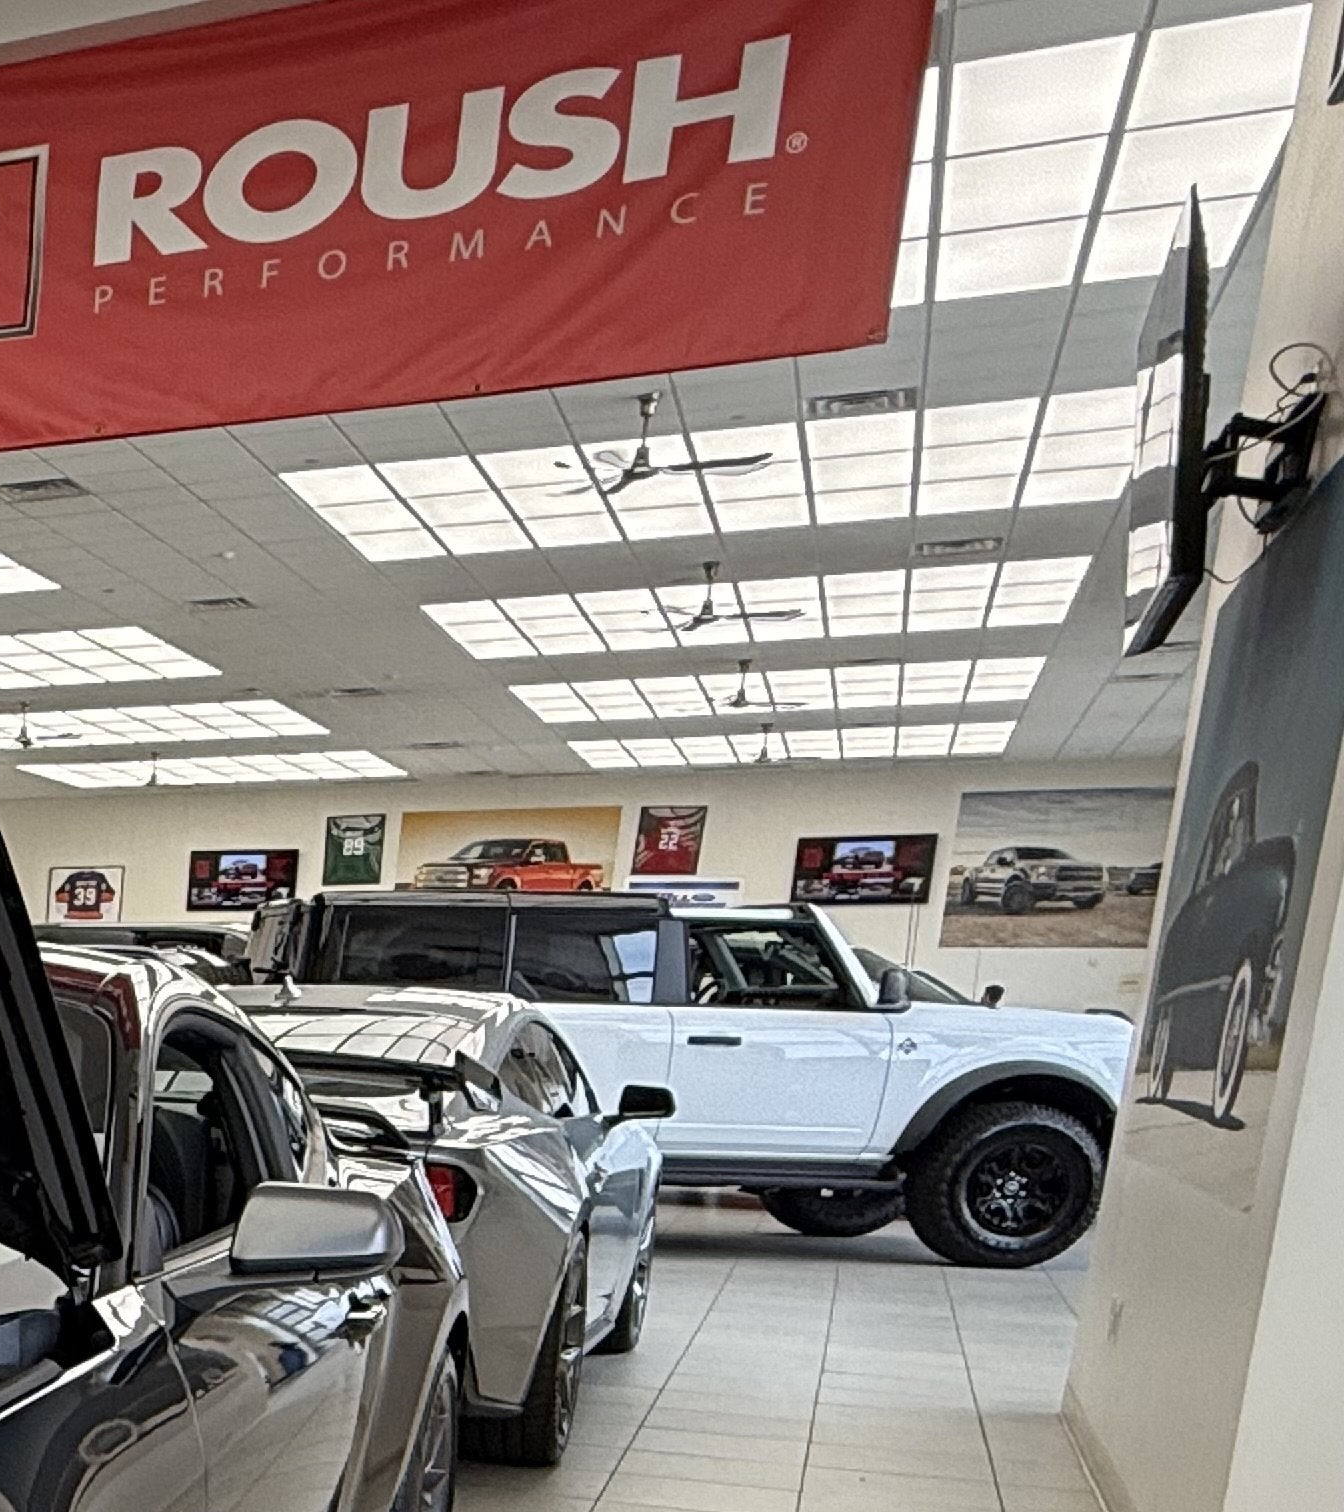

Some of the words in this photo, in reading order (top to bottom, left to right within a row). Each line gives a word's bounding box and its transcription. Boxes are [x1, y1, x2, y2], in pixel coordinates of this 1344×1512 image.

[92, 181, 770, 315] PERFORMANCE
[342, 836, 365, 856] 89
[658, 827, 681, 851] 22
[72, 888, 97, 906] 39
